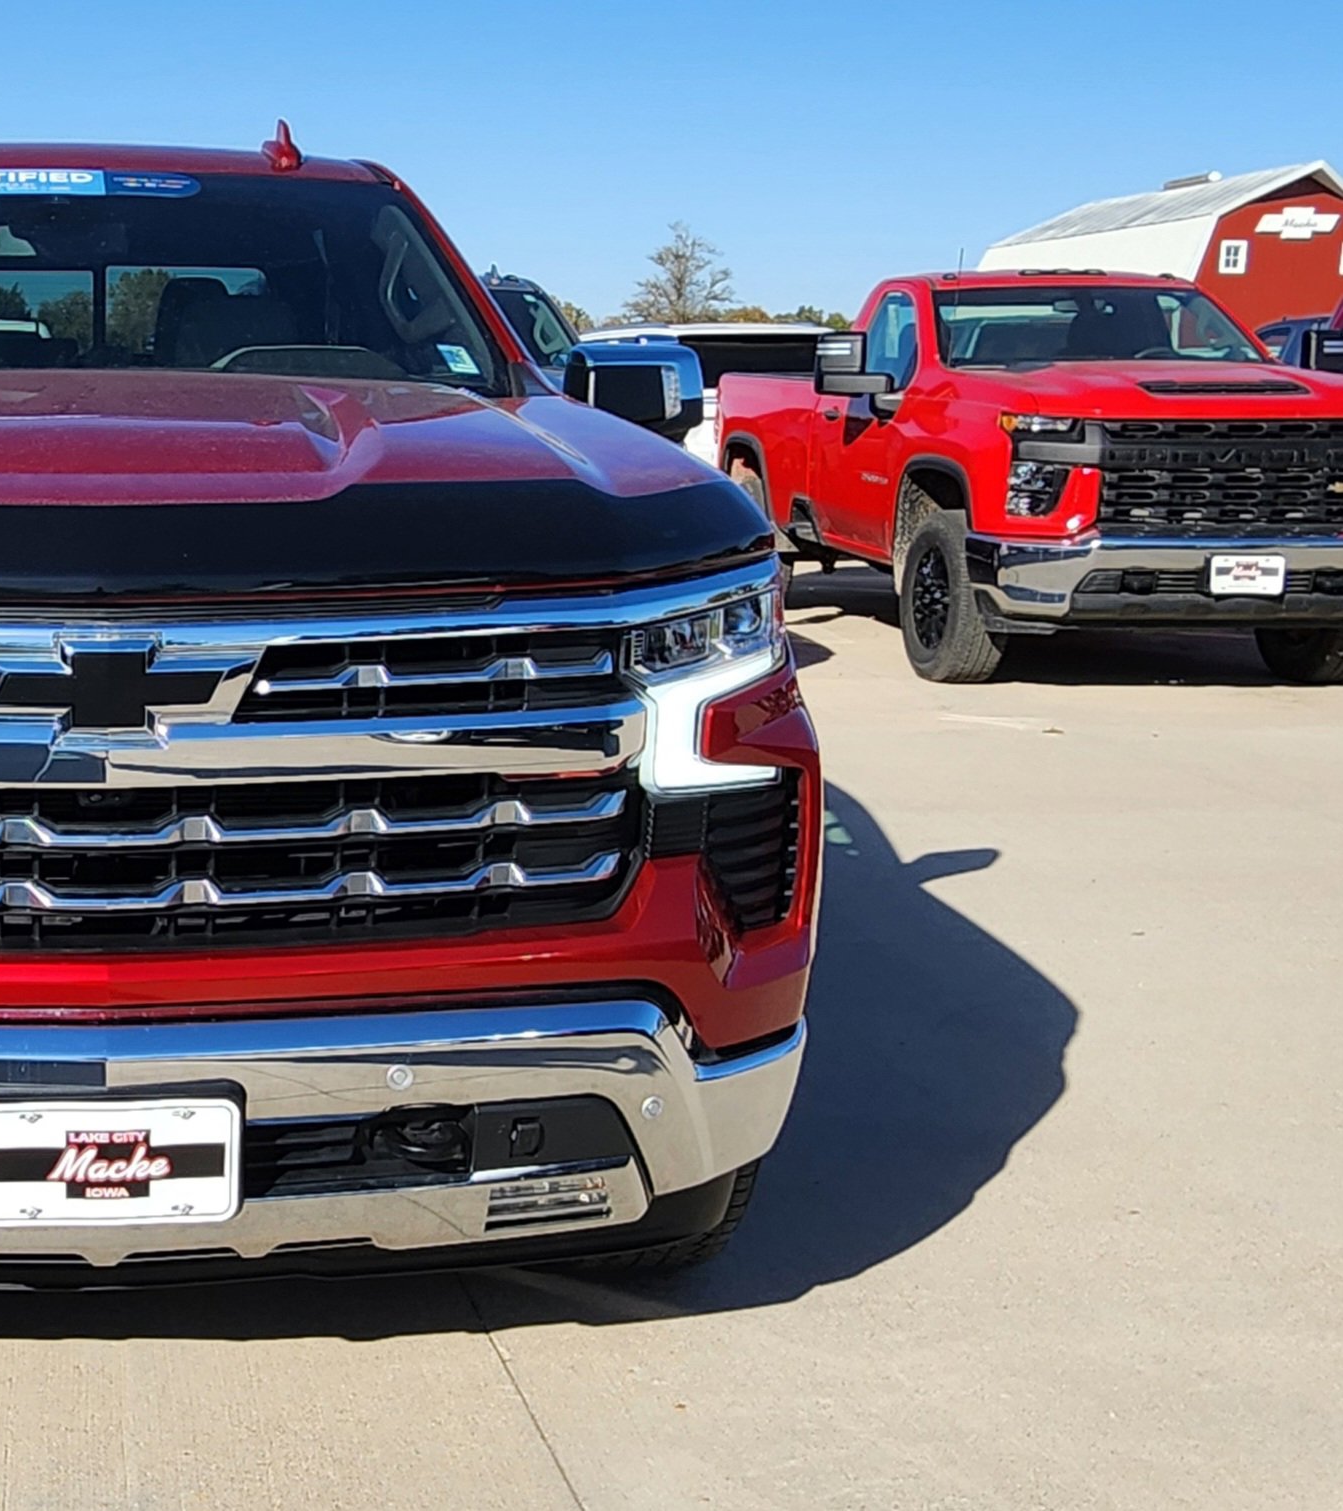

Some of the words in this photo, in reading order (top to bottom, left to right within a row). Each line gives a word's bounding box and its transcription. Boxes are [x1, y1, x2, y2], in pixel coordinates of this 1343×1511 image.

[68, 1132, 109, 1143] LAKE
[111, 1131, 147, 1143] CITY
[46, 1143, 171, 1182] Macke
[85, 1186, 130, 1199] IOWA
